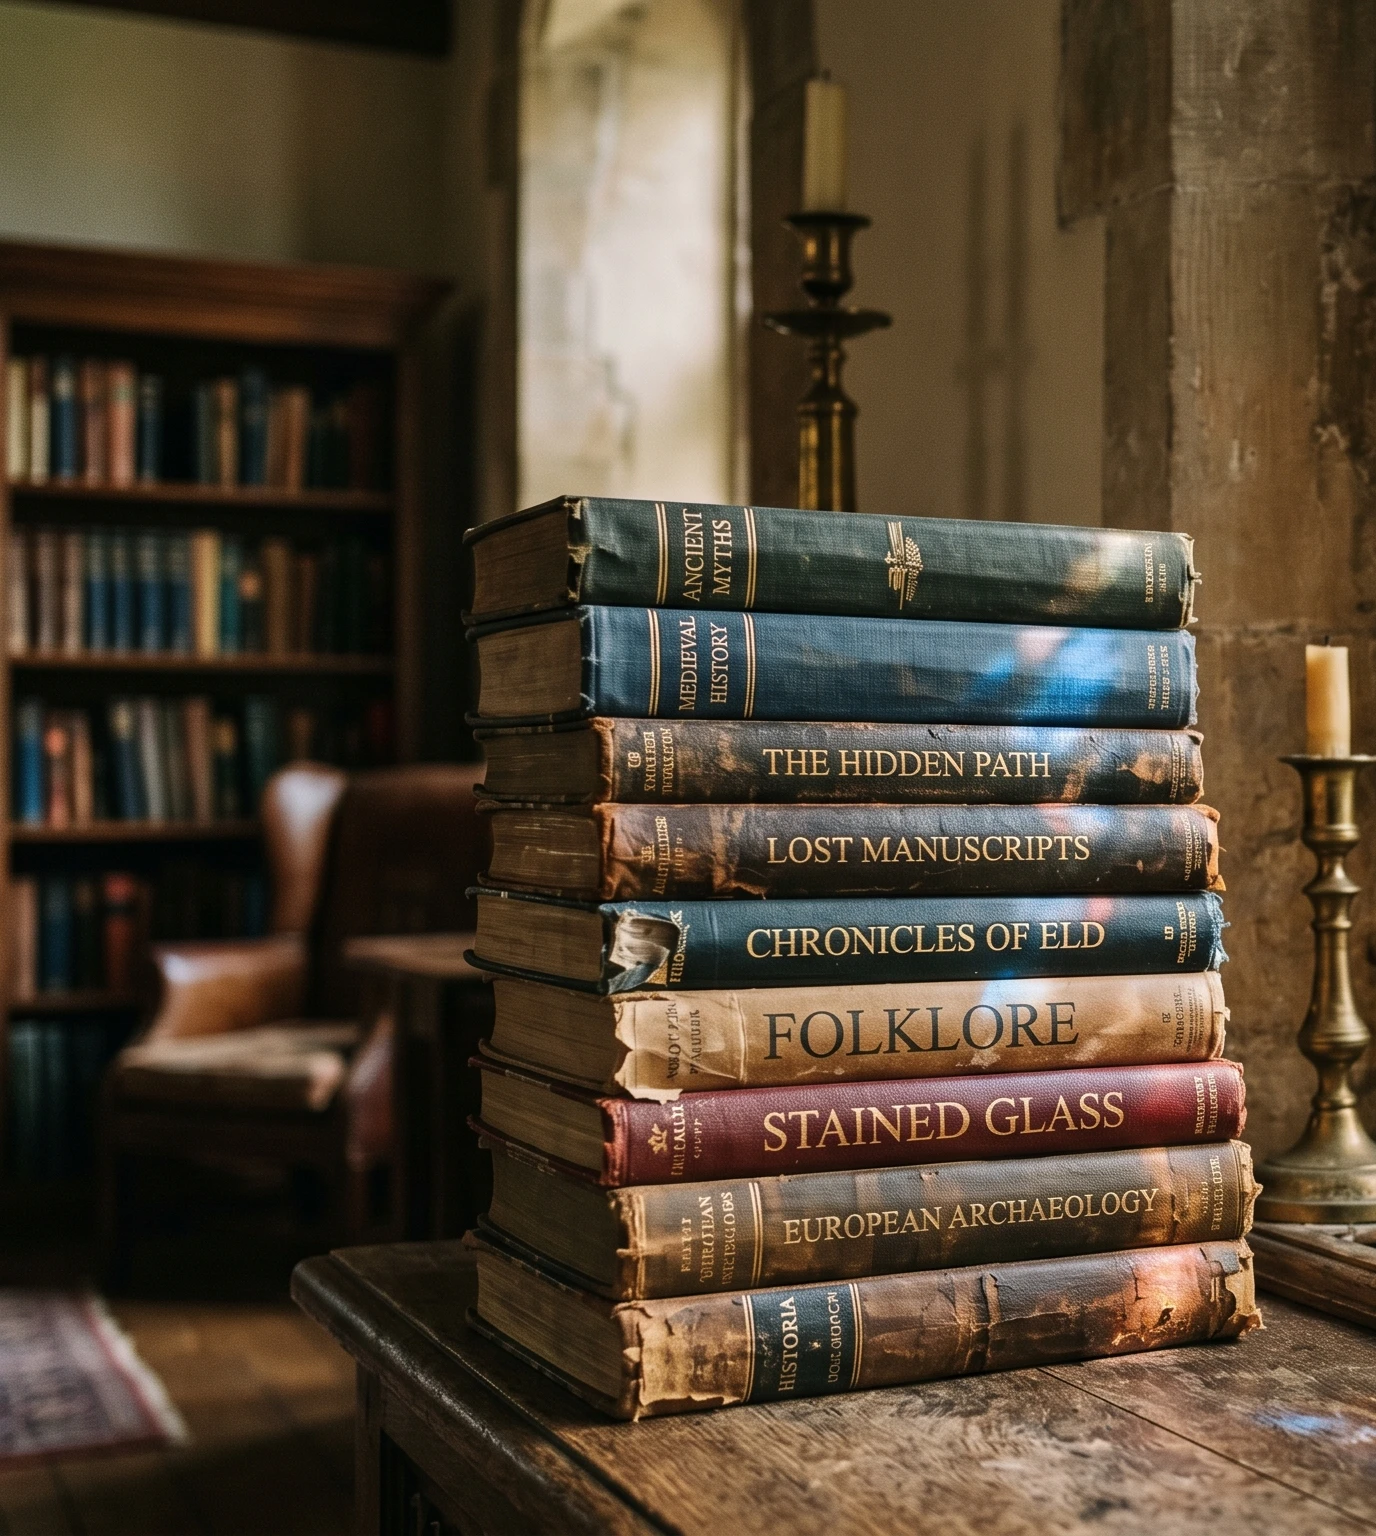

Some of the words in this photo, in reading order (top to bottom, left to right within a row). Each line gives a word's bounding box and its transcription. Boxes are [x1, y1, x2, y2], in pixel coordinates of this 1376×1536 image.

[682, 508, 704, 602] ANCIENT
[712, 519, 733, 595] MYTHS
[679, 615, 697, 711] MEDIEVAL
[710, 622, 729, 704] HISTORY
[762, 748, 830, 776] THE
[838, 750, 965, 777] HIDDEN
[973, 751, 1052, 778] PATH
[767, 837, 853, 864] LOST
[861, 835, 1091, 863] MANUSCRIPTS
[746, 923, 975, 958] CHRONICLES
[986, 921, 1029, 951] OF
[1039, 920, 1105, 949] ELD
[762, 1001, 1080, 1061] FOLKLORE
[763, 1102, 971, 1152] STAINED
[985, 1091, 1125, 1136] GLASS
[783, 1206, 942, 1245] EUROPEAN
[947, 1188, 1160, 1233] ARCHAEOLOGY
[778, 1296, 799, 1392] HISTORIA
